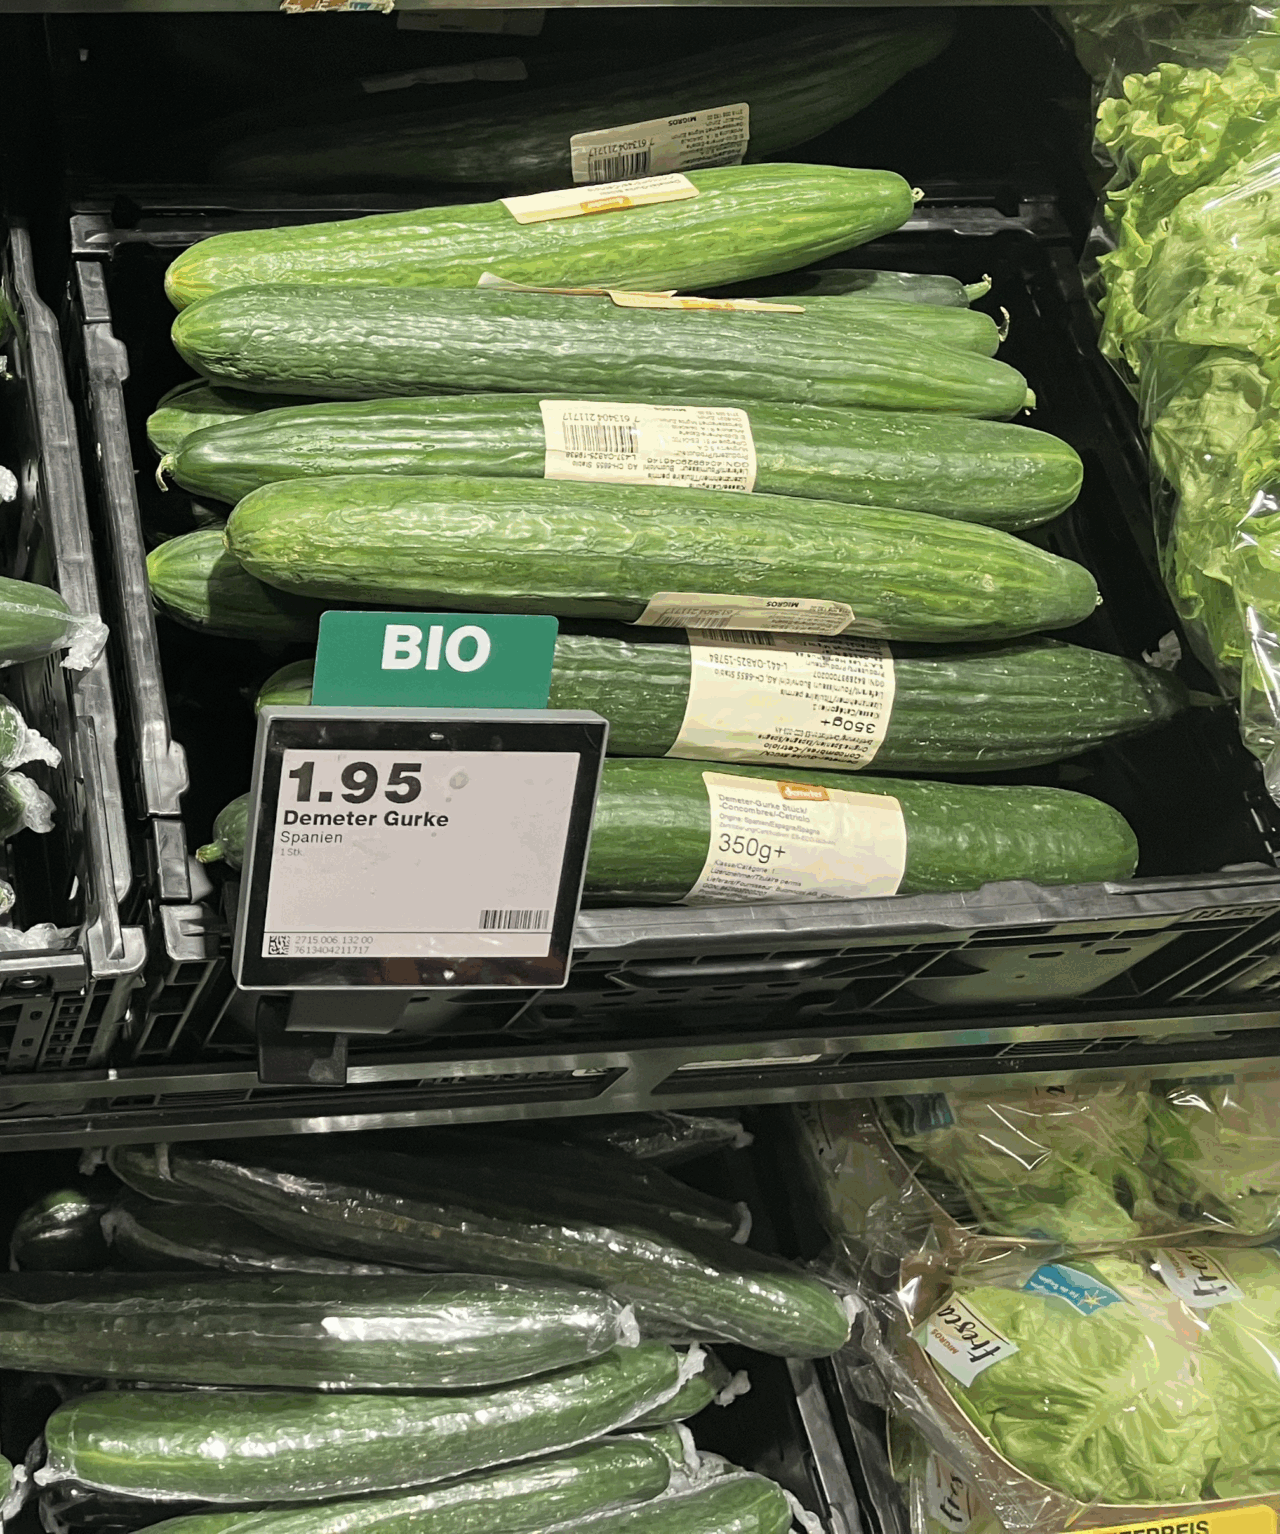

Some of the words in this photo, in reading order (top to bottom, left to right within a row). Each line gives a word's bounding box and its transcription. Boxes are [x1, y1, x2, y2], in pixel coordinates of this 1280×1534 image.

[667, 116, 697, 127] MIGROS
[562, 412, 596, 422] 211717
[597, 413, 630, 423] 613404
[380, 623, 492, 673] BIO
[820, 716, 876, 734] 350g+
[288, 760, 422, 804] 1.95
[718, 793, 780, 811] Demeter-Gurke
[283, 810, 377, 827] Demeter
[384, 811, 449, 828] Gurke
[280, 830, 343, 846] Spanien
[718, 833, 786, 864] 350g+
[295, 935, 319, 944] 2715
[320, 935, 339, 944] 006
[343, 935, 360, 944] 132
[361, 935, 374, 944] 00
[294, 945, 370, 955] 7613404211717
[930, 1328, 960, 1355] MIGROS
